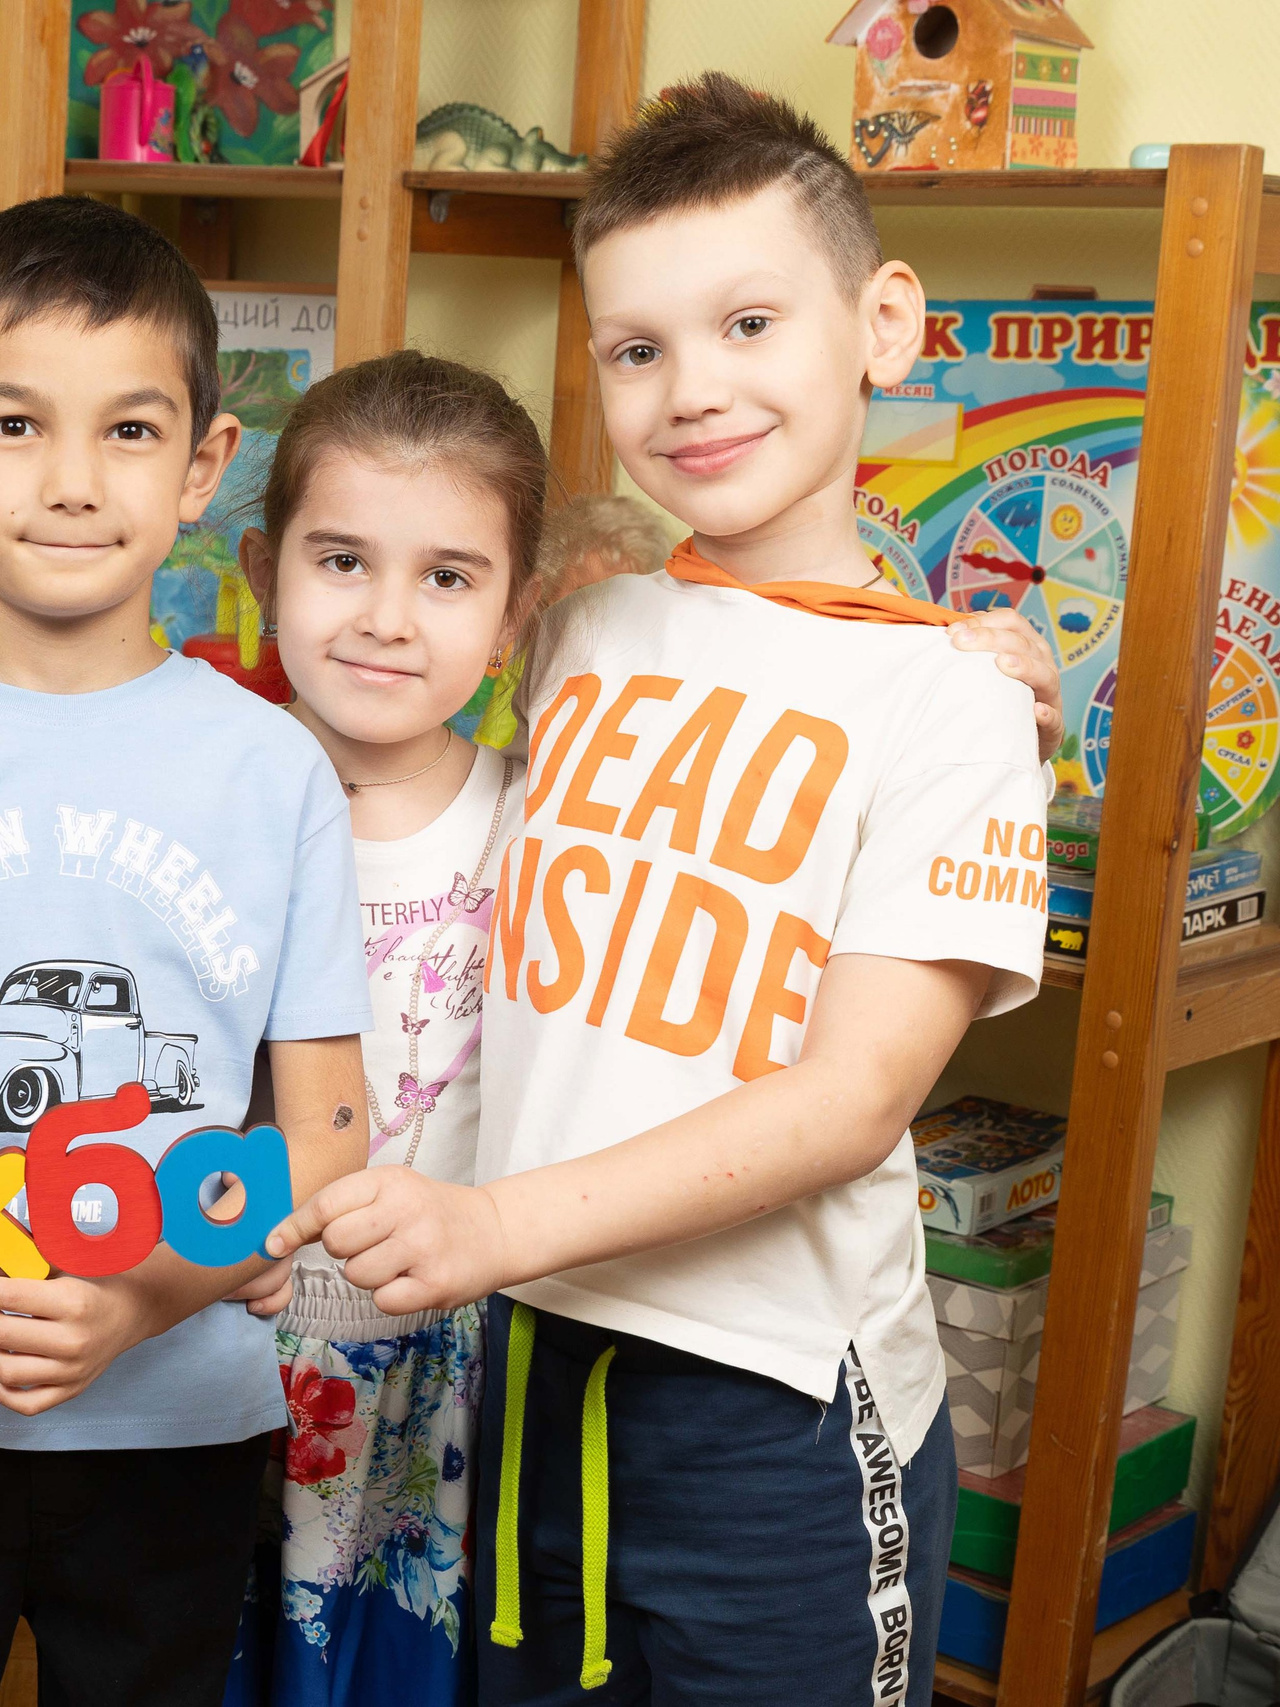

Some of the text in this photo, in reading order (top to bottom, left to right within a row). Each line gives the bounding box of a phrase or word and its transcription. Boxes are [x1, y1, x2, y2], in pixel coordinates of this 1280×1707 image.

[291, 303, 337, 333] ДО
[883, 385, 934, 399] МЕСЯЦ
[984, 446, 1111, 489] ПОГОДА
[1050, 477, 1110, 517] СОЛНЕЧНО
[1220, 578, 1280, 626] ЕНЬ
[1067, 603, 1120, 662] ПАСМУРНО
[524, 672, 850, 885] DEAD
[1217, 747, 1251, 766] СРЕДА
[982, 817, 1045, 862] NO
[54, 803, 260, 1002] WHEELS
[928, 855, 1047, 914] COMM
[483, 834, 832, 1083] NSIDE
[1006, 1170, 1056, 1213] ЛОТО
[855, 1432, 907, 1595] AWESOME
[877, 1603, 907, 1699] BORN
